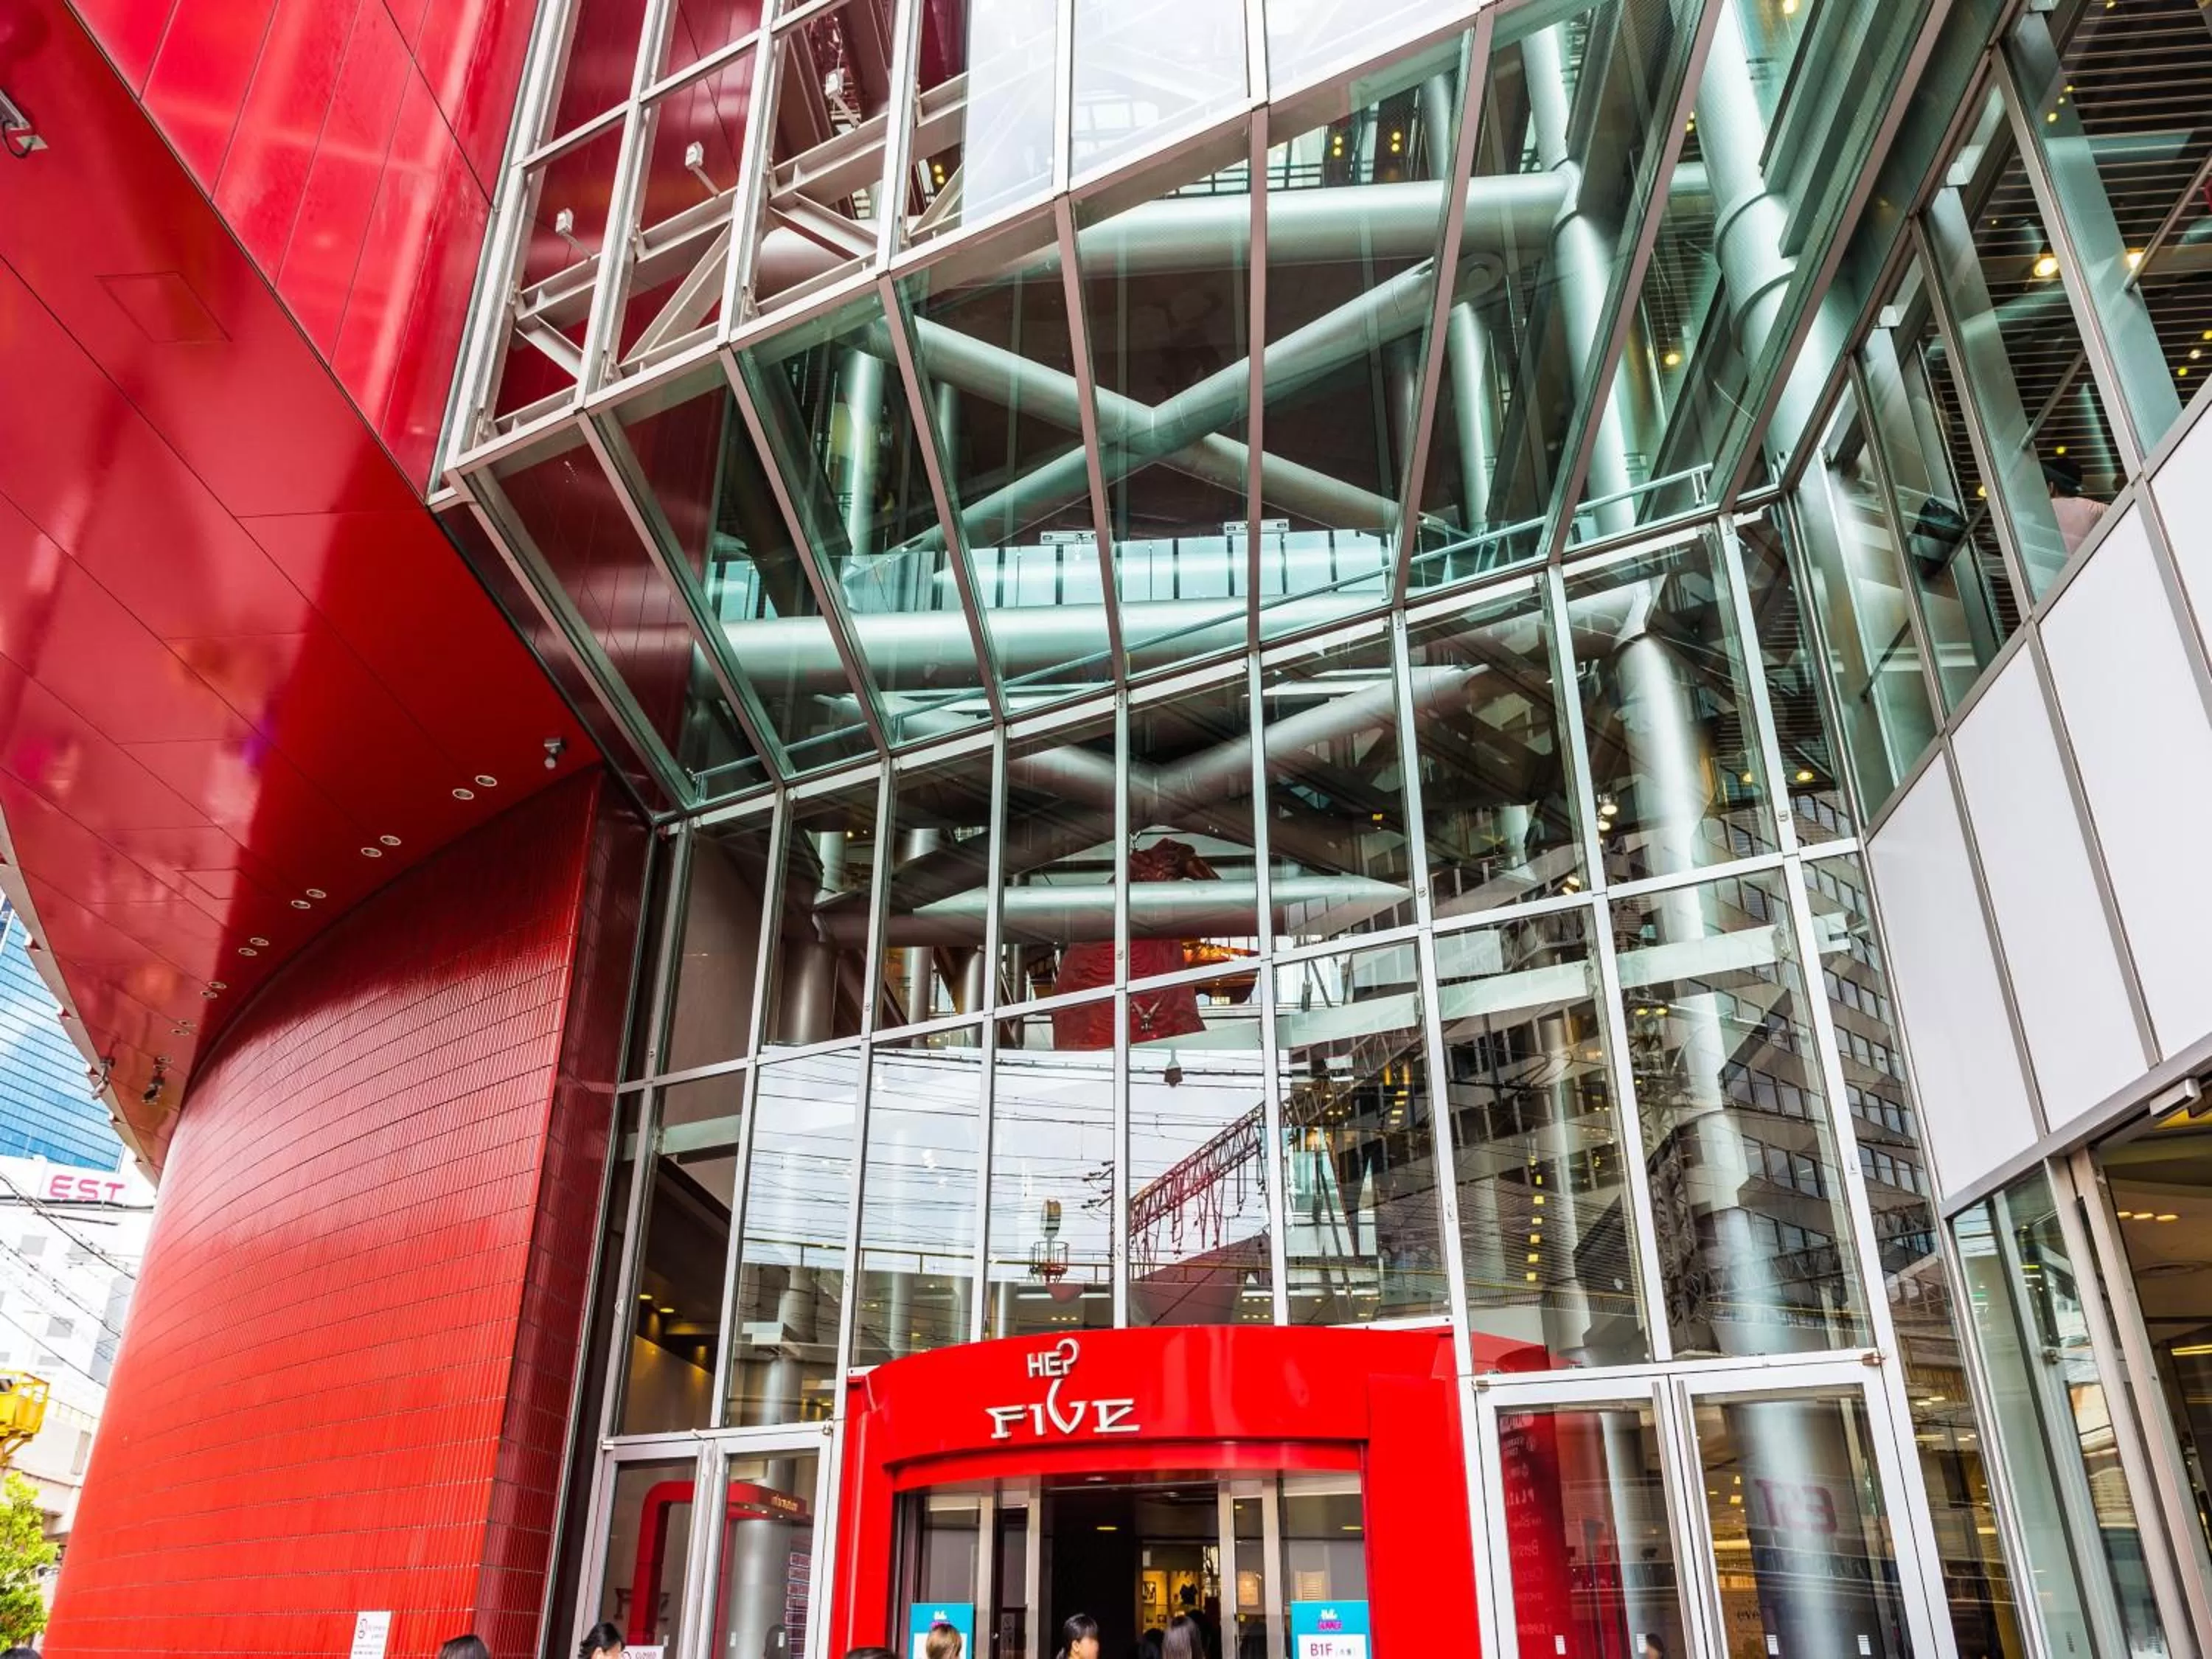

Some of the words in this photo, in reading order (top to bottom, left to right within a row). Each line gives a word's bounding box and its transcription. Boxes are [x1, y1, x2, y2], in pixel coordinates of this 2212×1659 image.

[49, 1175, 125, 1200] EST
[1026, 1338, 1080, 1377] HEP
[985, 1378, 1141, 1439] FIVE
[1310, 1643, 1333, 1657] B1F
